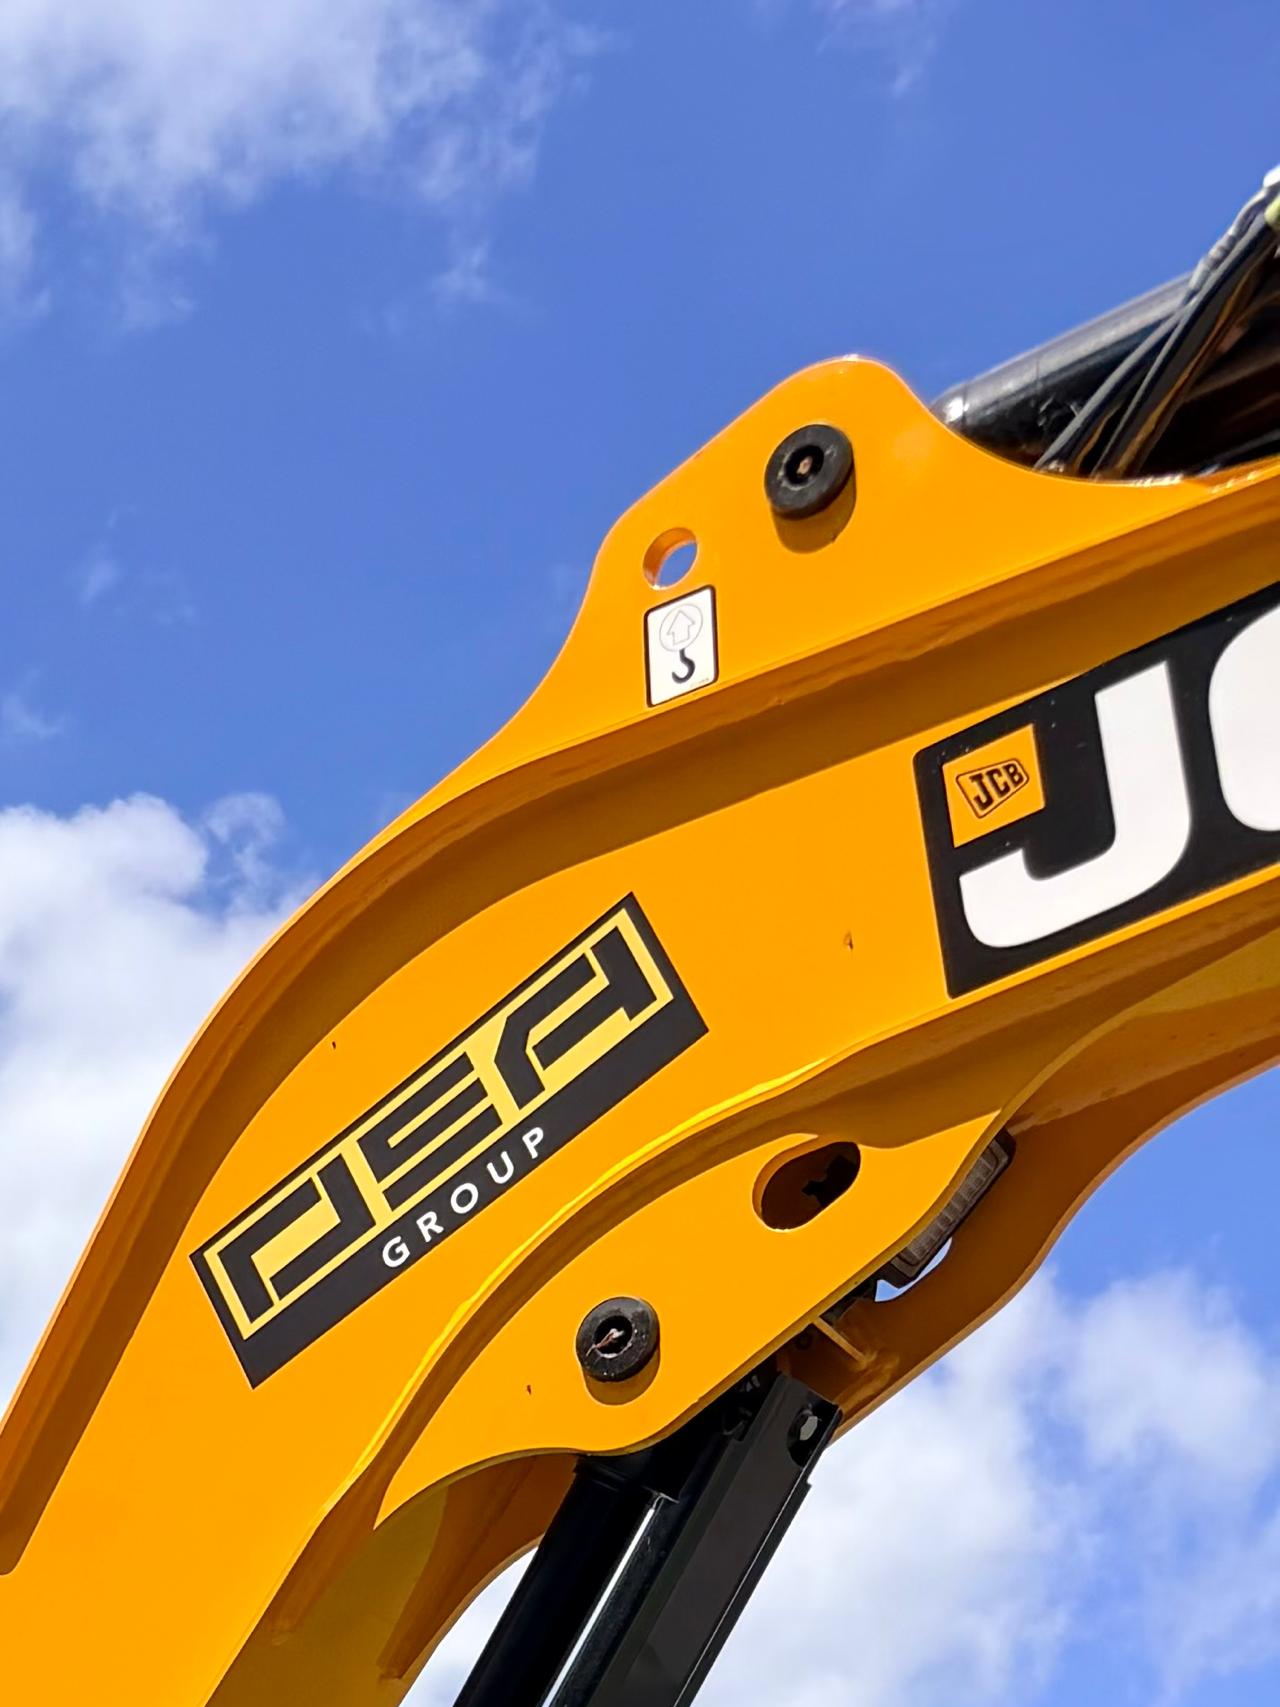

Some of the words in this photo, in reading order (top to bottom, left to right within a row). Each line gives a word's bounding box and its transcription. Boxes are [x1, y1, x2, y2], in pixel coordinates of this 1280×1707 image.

[968, 759, 1024, 812] JCB
[217, 925, 658, 1324] OSA
[382, 1127, 546, 1268] GROUP
